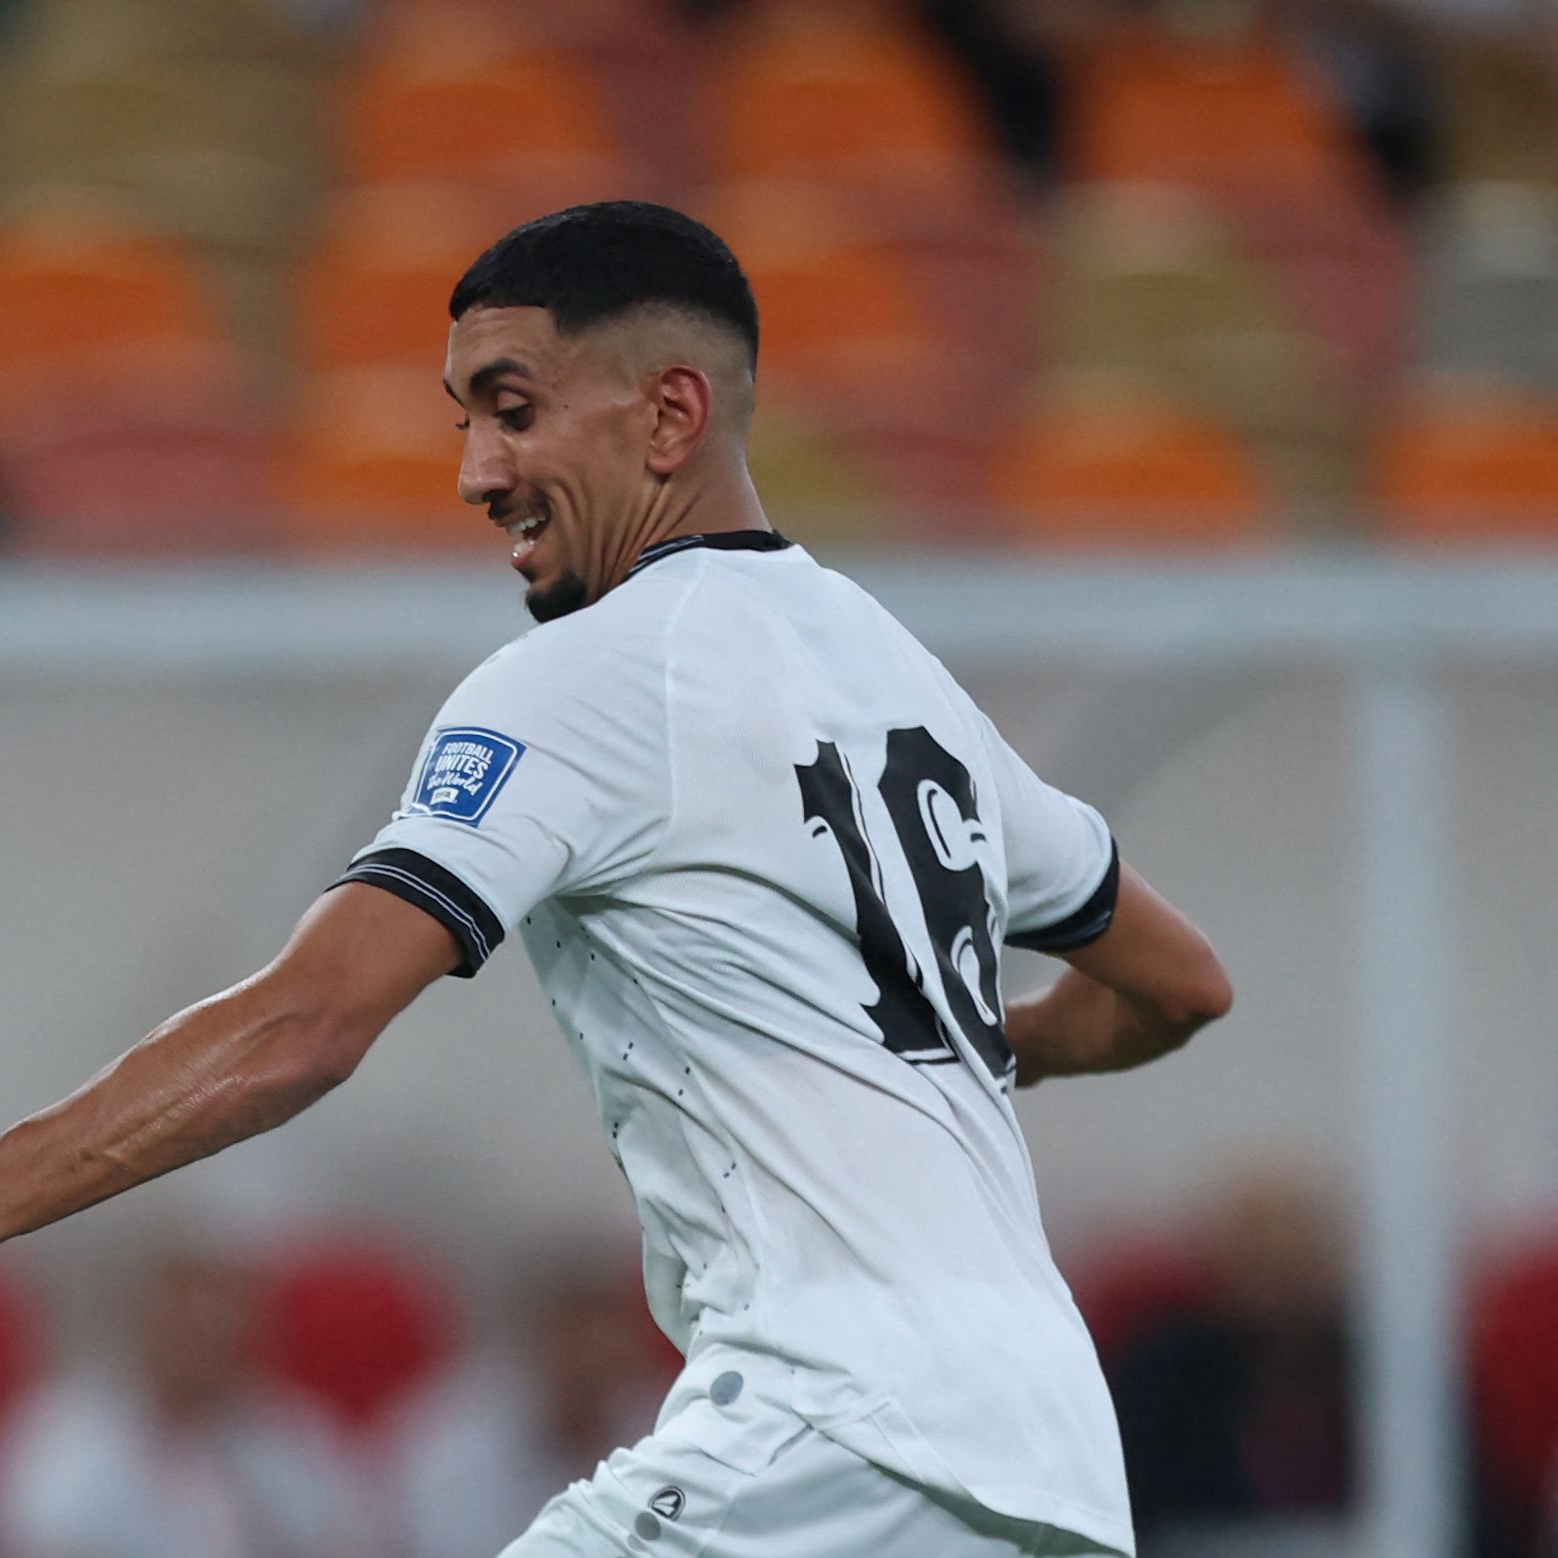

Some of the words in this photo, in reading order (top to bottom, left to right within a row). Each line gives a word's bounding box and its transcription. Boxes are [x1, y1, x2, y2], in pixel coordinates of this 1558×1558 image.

[442, 742, 494, 764] FOOTBALL
[435, 754, 489, 779] UNITES
[793, 725, 1017, 1080] 16
